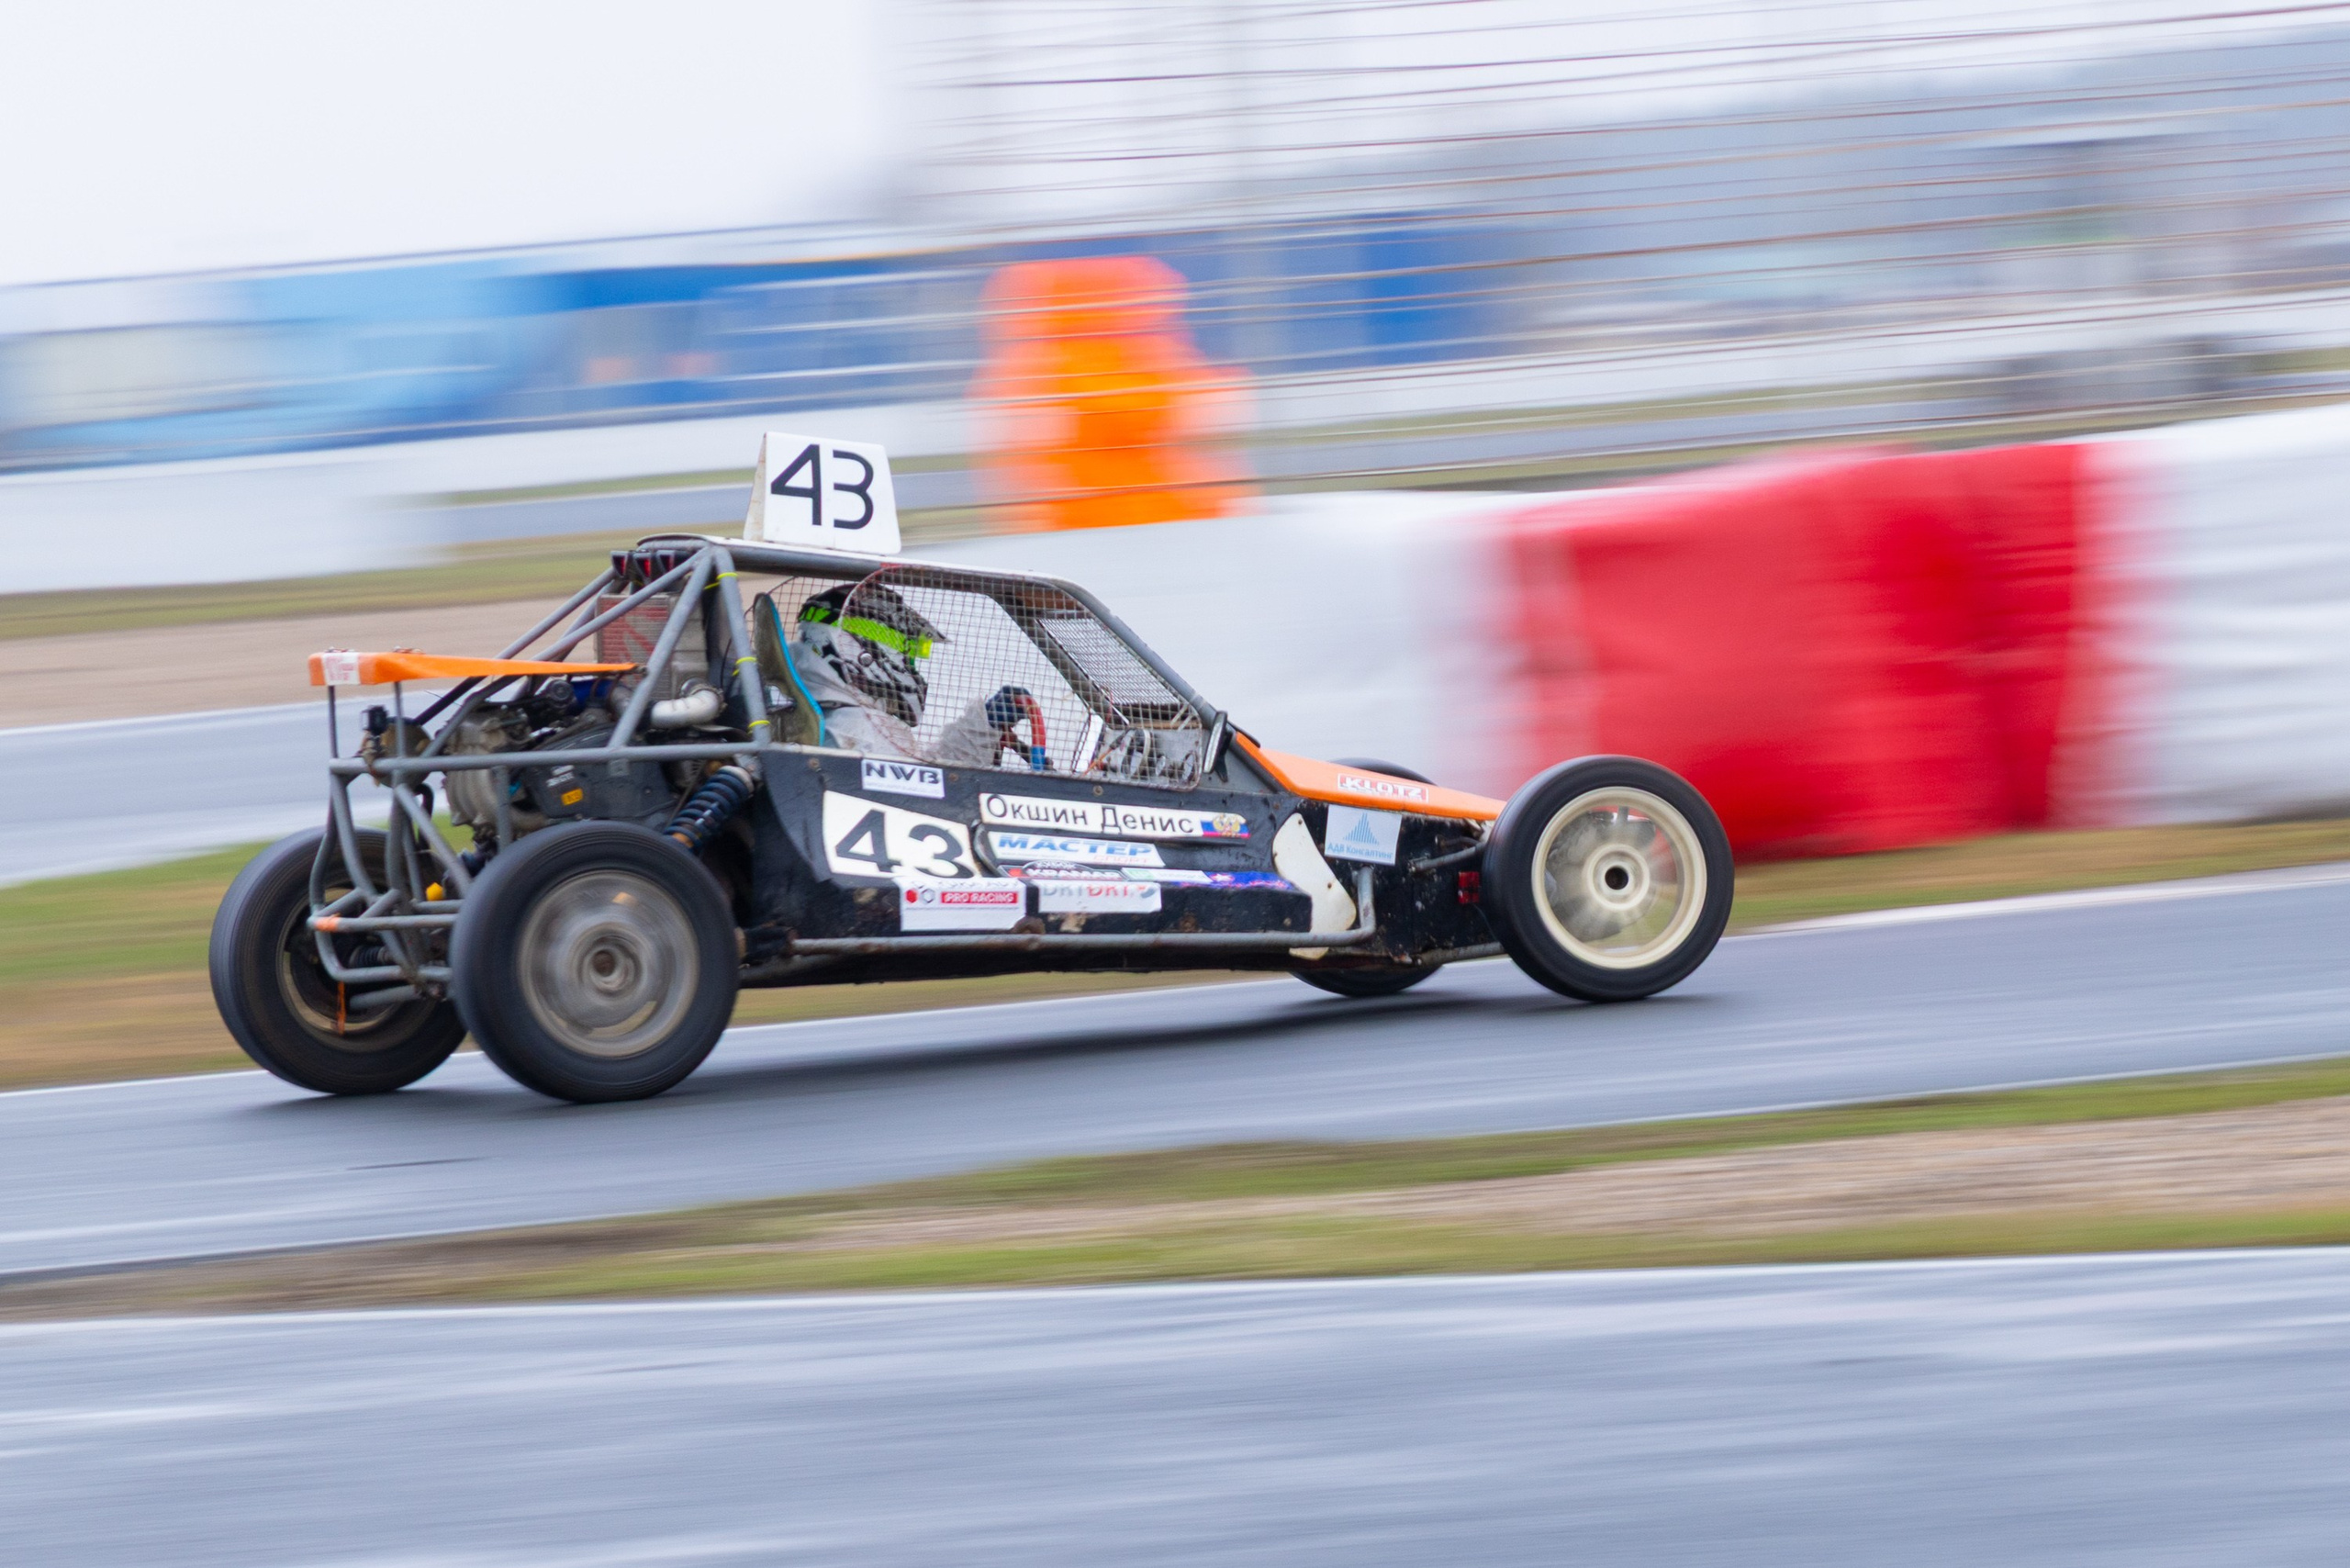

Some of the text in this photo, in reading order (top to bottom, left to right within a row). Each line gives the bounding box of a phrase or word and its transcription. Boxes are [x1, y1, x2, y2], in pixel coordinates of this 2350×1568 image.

[771, 444, 874, 530] 43
[866, 763, 939, 784] NWB
[1342, 777, 1422, 799] KLOTZ
[987, 794, 1194, 834] Окшин Денис
[835, 809, 975, 879] 43
[998, 834, 1152, 857] МАСТЕР
[971, 892, 1014, 903] RACING
